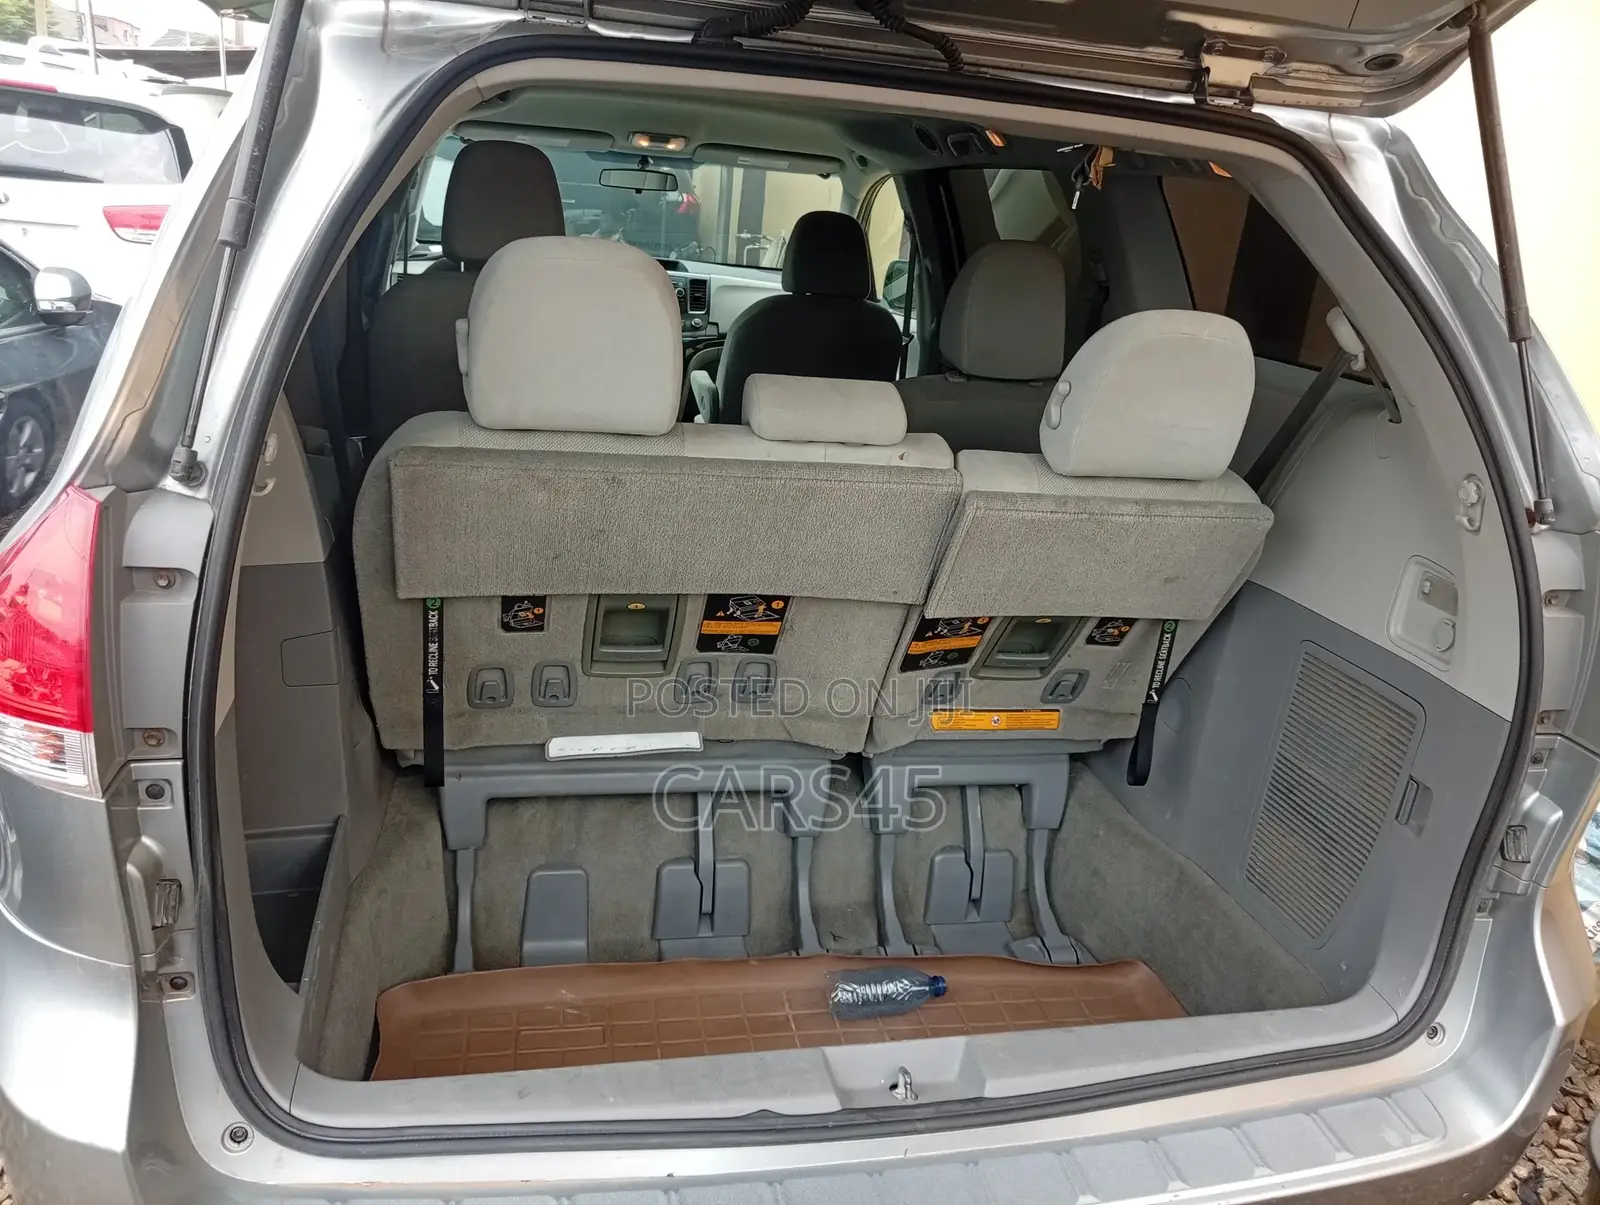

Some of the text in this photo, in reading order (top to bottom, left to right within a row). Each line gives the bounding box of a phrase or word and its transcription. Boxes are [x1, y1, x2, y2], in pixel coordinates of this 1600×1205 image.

[428, 643, 439, 667] RECLINE
[1159, 633, 1172, 660] SEATBACK
[428, 667, 439, 676] TO
[1153, 660, 1166, 682] RECLINE
